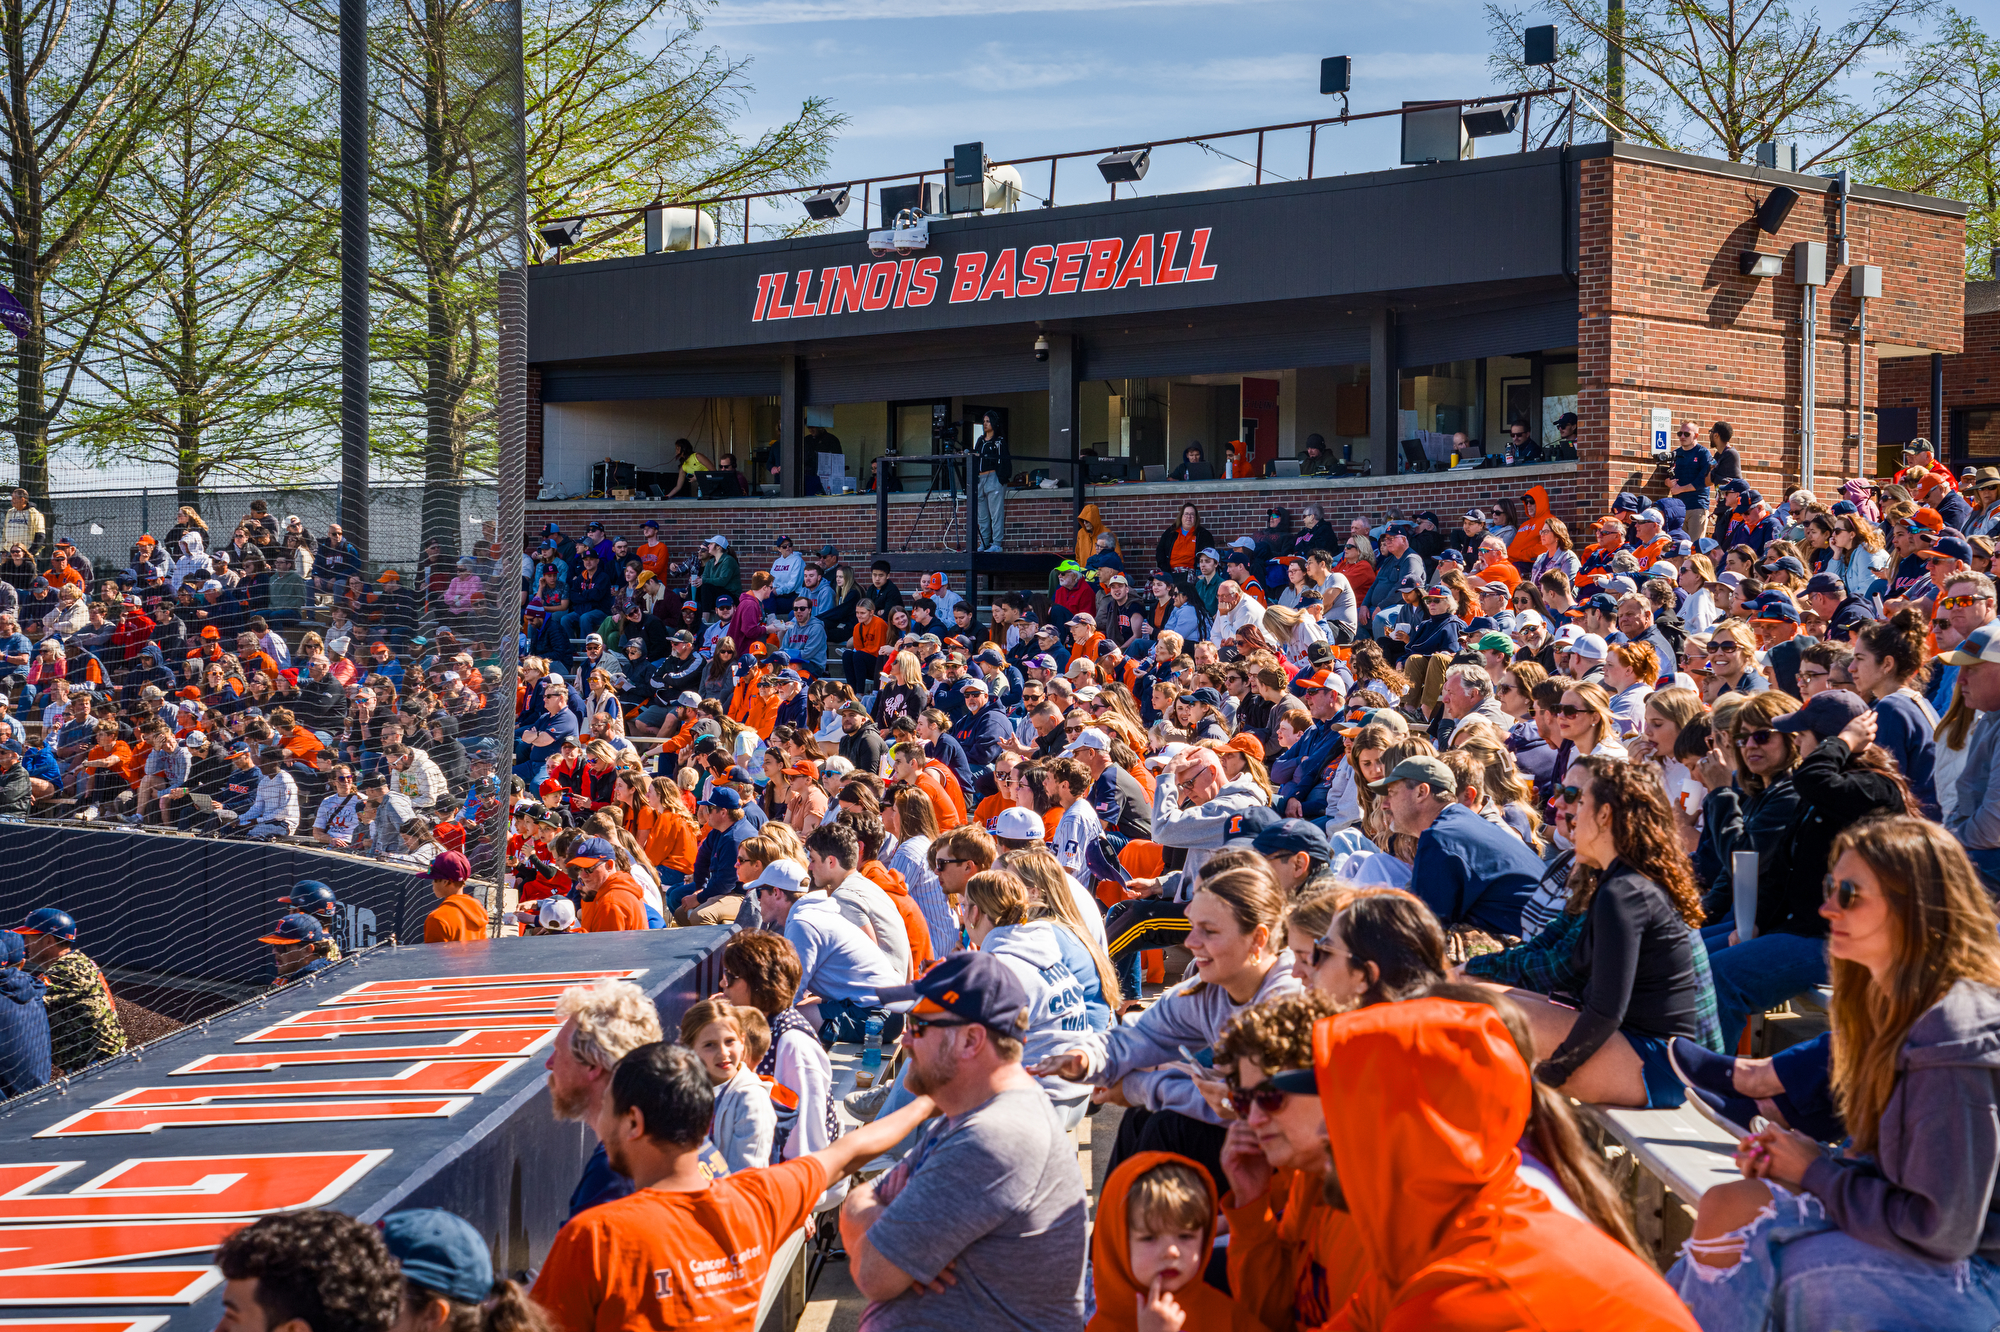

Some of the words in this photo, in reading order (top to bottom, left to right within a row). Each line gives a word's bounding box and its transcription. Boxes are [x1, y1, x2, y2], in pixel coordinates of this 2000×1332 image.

[752, 256, 942, 322] ILLINOIS
[949, 227, 1218, 304] BASEBALL
[689, 1257, 727, 1273] Cancer
[706, 1267, 744, 1286] Illinois
